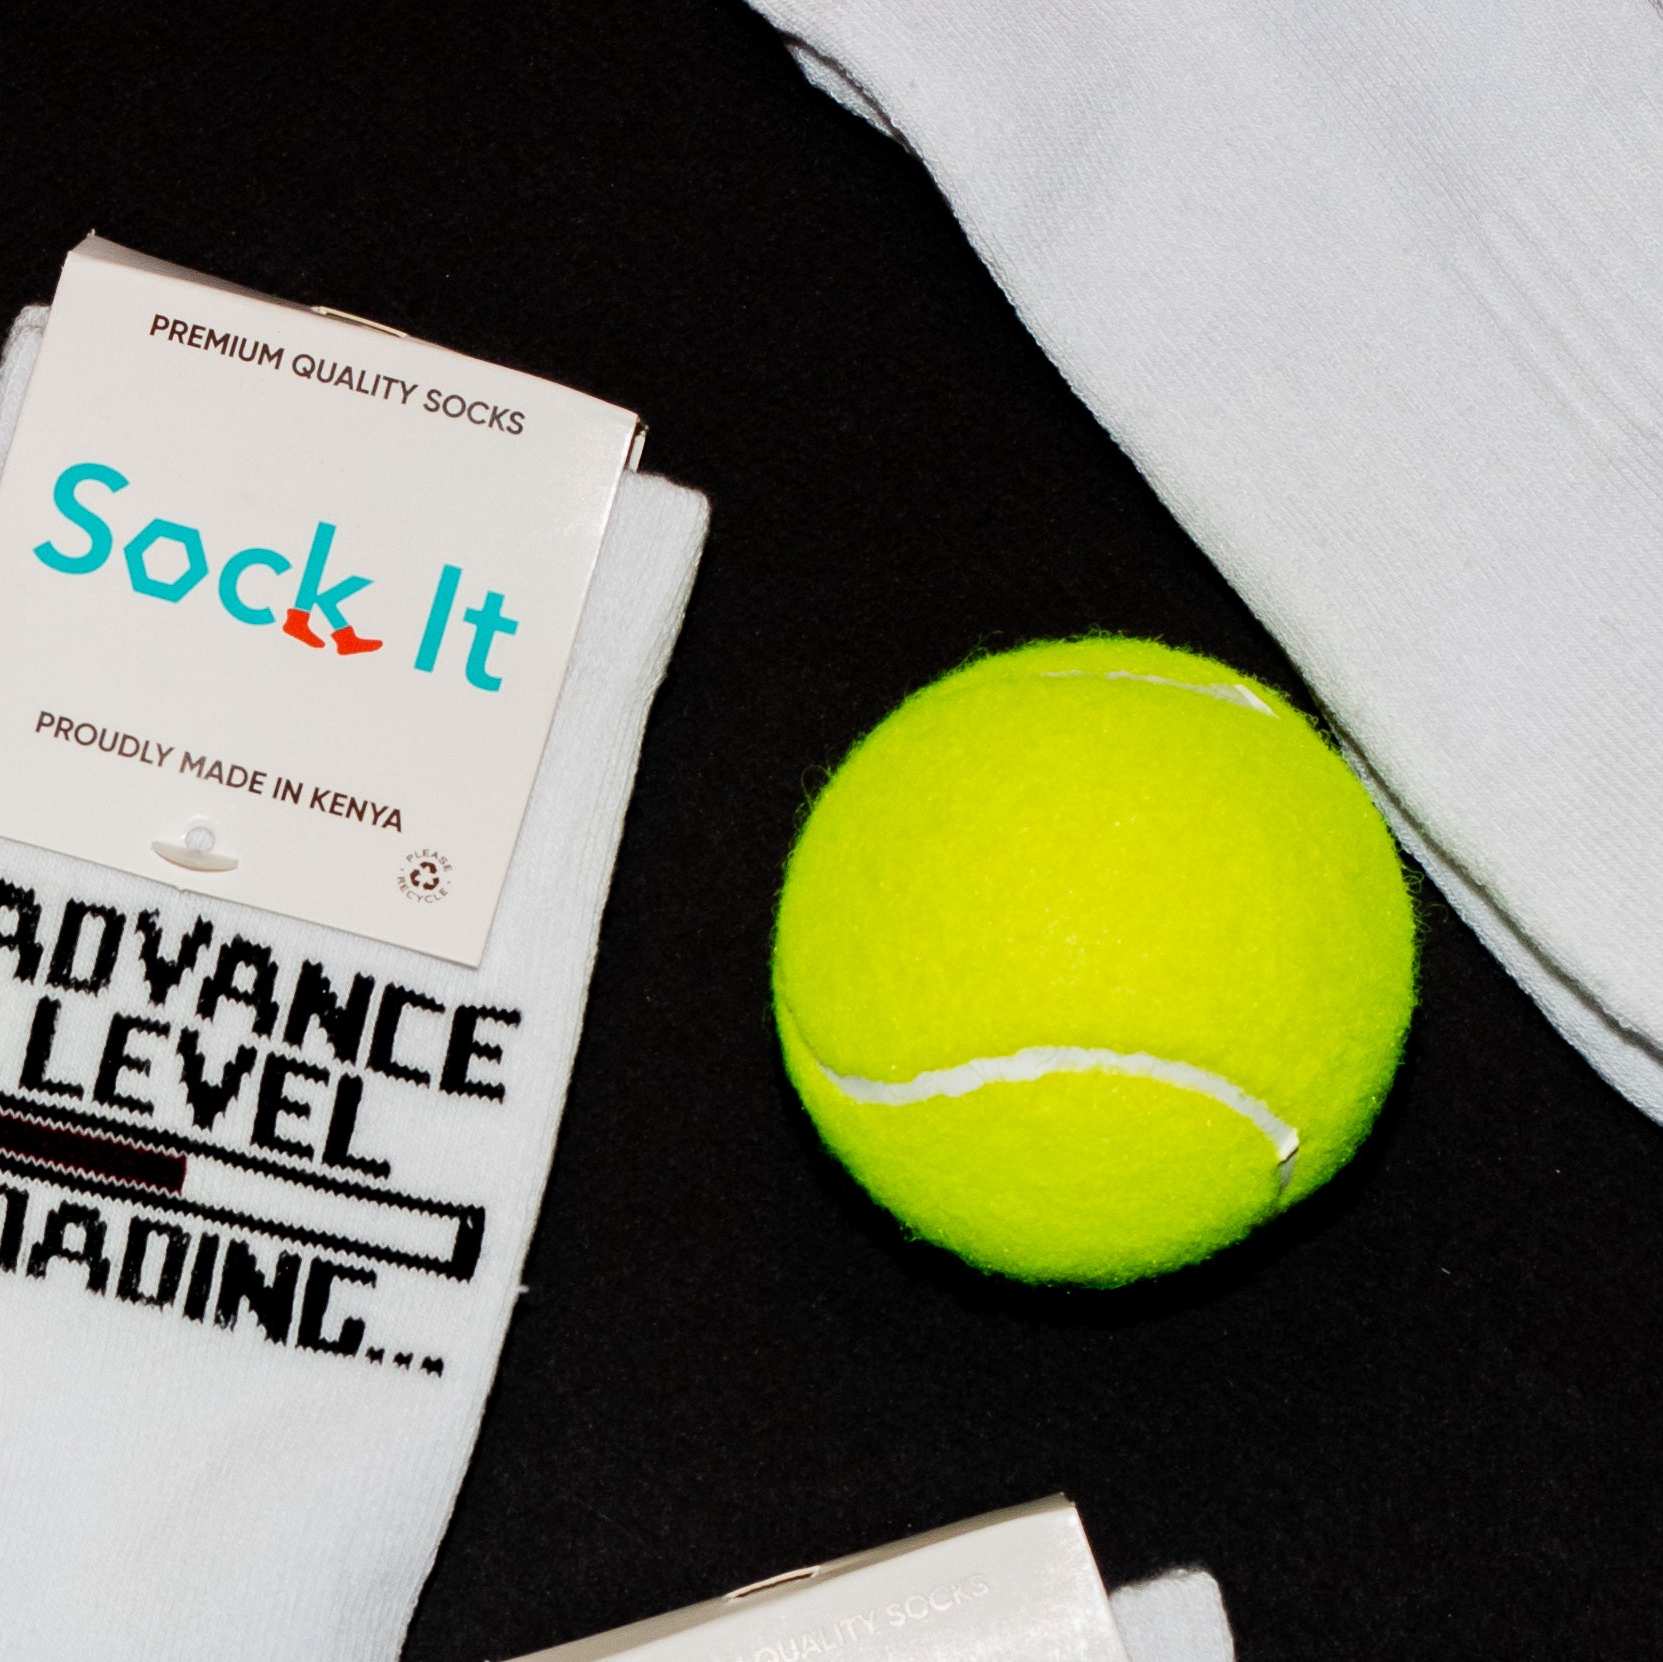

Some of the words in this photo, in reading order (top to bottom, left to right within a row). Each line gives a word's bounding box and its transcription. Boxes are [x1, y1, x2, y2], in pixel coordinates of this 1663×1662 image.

[149, 314, 284, 371] PREMIUM
[291, 353, 419, 405] QUALITY
[424, 388, 525, 436] SOCKS
[33, 462, 384, 656] Sock
[414, 563, 519, 692] It
[35, 711, 175, 768] PROUDLY
[179, 755, 267, 794] MADE
[272, 778, 302, 806] IN
[309, 788, 404, 834] KENYA
[397, 876, 449, 903] RECYCLE
[406, 849, 453, 872] PLEASE
[20, 996, 390, 1179] LEVEL
[886, 1572, 991, 1630] SOCKS
